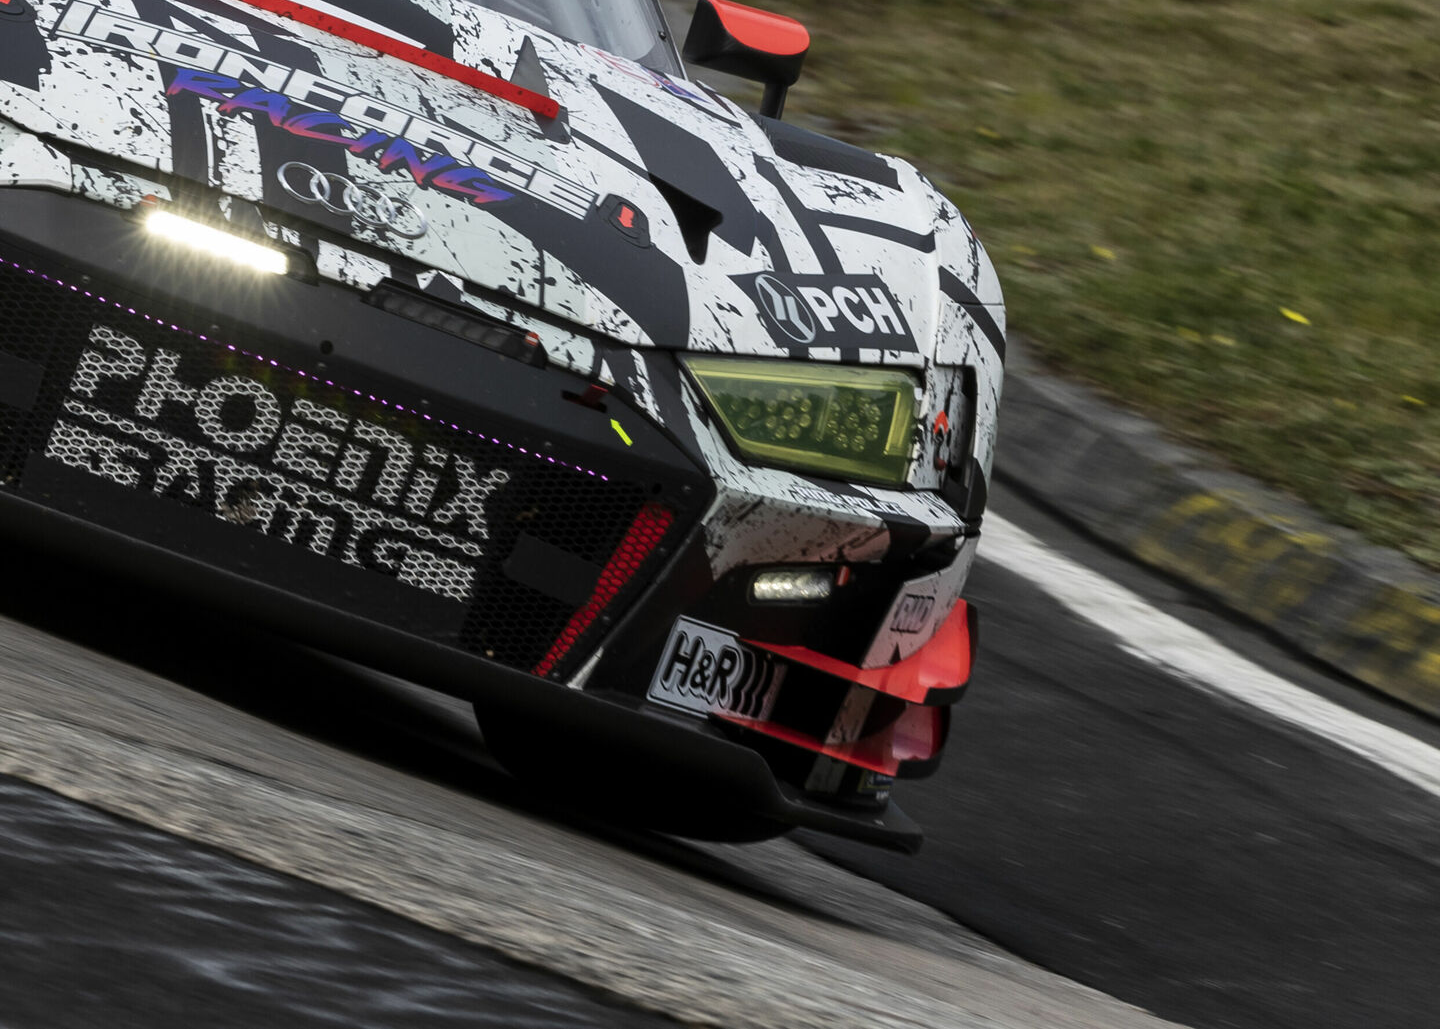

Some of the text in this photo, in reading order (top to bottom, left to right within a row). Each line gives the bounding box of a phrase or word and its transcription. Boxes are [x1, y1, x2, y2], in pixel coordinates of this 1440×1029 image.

[53, 0, 598, 221] IRONFORCE
[166, 68, 516, 204] RACING
[797, 286, 906, 335] PCH
[661, 631, 738, 703] H&R
